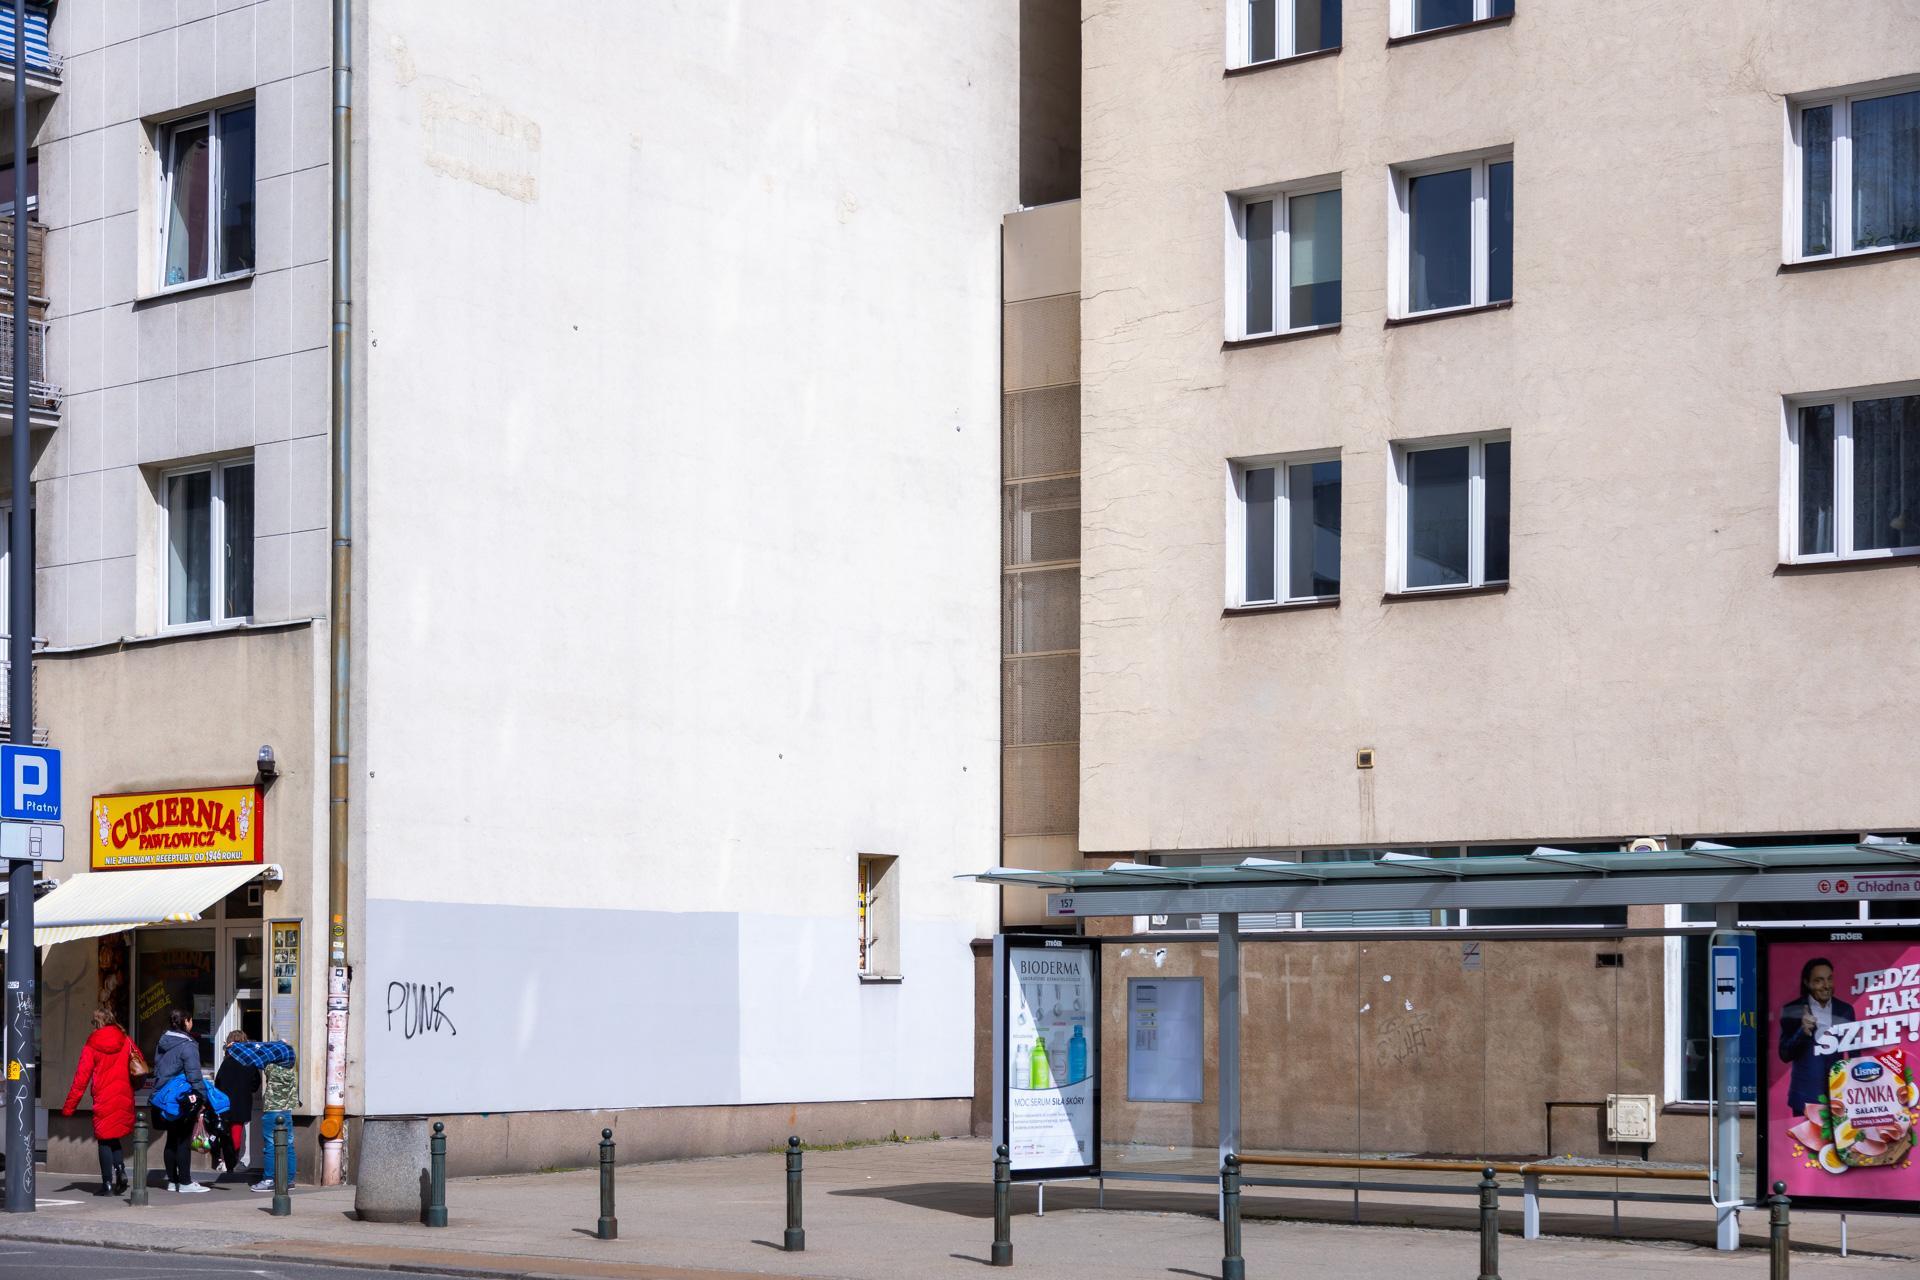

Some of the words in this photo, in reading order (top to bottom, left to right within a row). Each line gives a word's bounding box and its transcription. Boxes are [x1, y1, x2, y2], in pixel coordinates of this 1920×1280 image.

[14, 754, 49, 810] P
[26, 800, 59, 815] Płatny
[111, 796, 237, 849] CUKIERNIA
[138, 830, 217, 850] PAWŁOWICZ
[105, 856, 116, 865] NIE
[117, 855, 155, 865] ZMIENIAMY
[155, 853, 192, 864] RECEPTURY
[194, 852, 204, 862] OD
[205, 849, 221, 861] 1946
[1856, 879, 1911, 893] Chłodna
[1060, 898, 1074, 909] 157
[1830, 931, 1863, 941] STRÖER
[1020, 960, 1080, 975] BIODERMA
[1851, 964, 1920, 995] JEDZ
[387, 981, 457, 1040] PUNK
[1865, 989, 1920, 1016] JAK
[1814, 1012, 1920, 1056] SZEF!
[1854, 1066, 1881, 1076] Lisner
[1052, 1097, 1065, 1106] SIŁA
[1065, 1095, 1085, 1105] SKÓRY
[1847, 1084, 1895, 1105] SZYNKA
[1855, 1105, 1889, 1115] SAŁATKA
